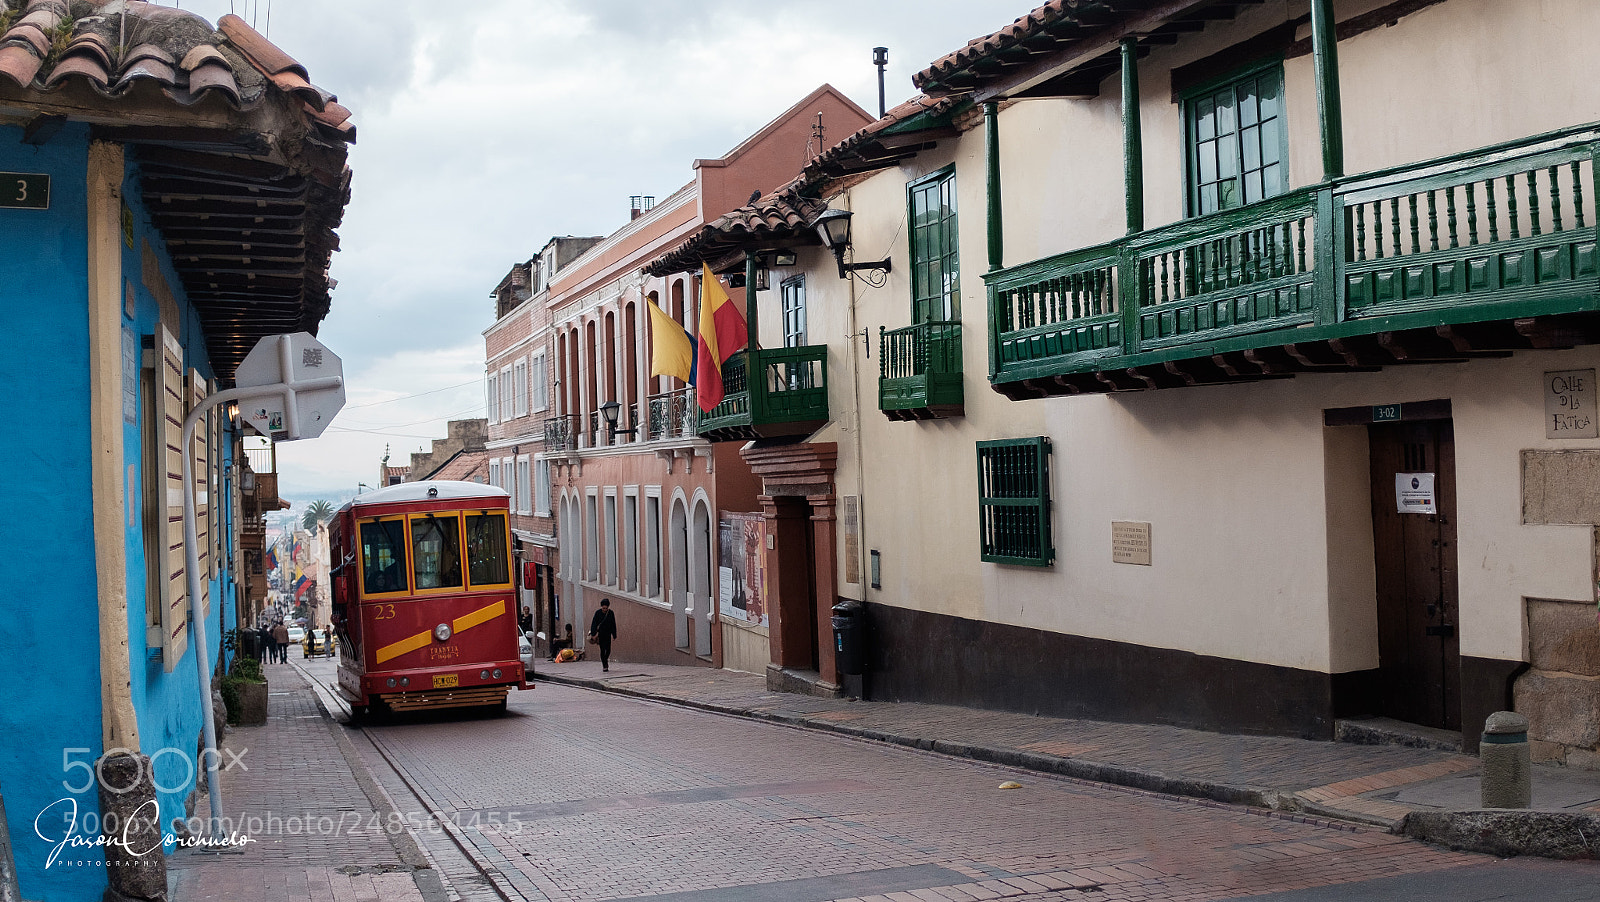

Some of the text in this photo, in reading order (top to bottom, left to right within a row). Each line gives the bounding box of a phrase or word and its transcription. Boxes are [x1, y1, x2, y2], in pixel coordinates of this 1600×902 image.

[16, 180, 27, 201] 3
[1379, 407, 1395, 418] 3-02
[375, 604, 395, 619] 23
